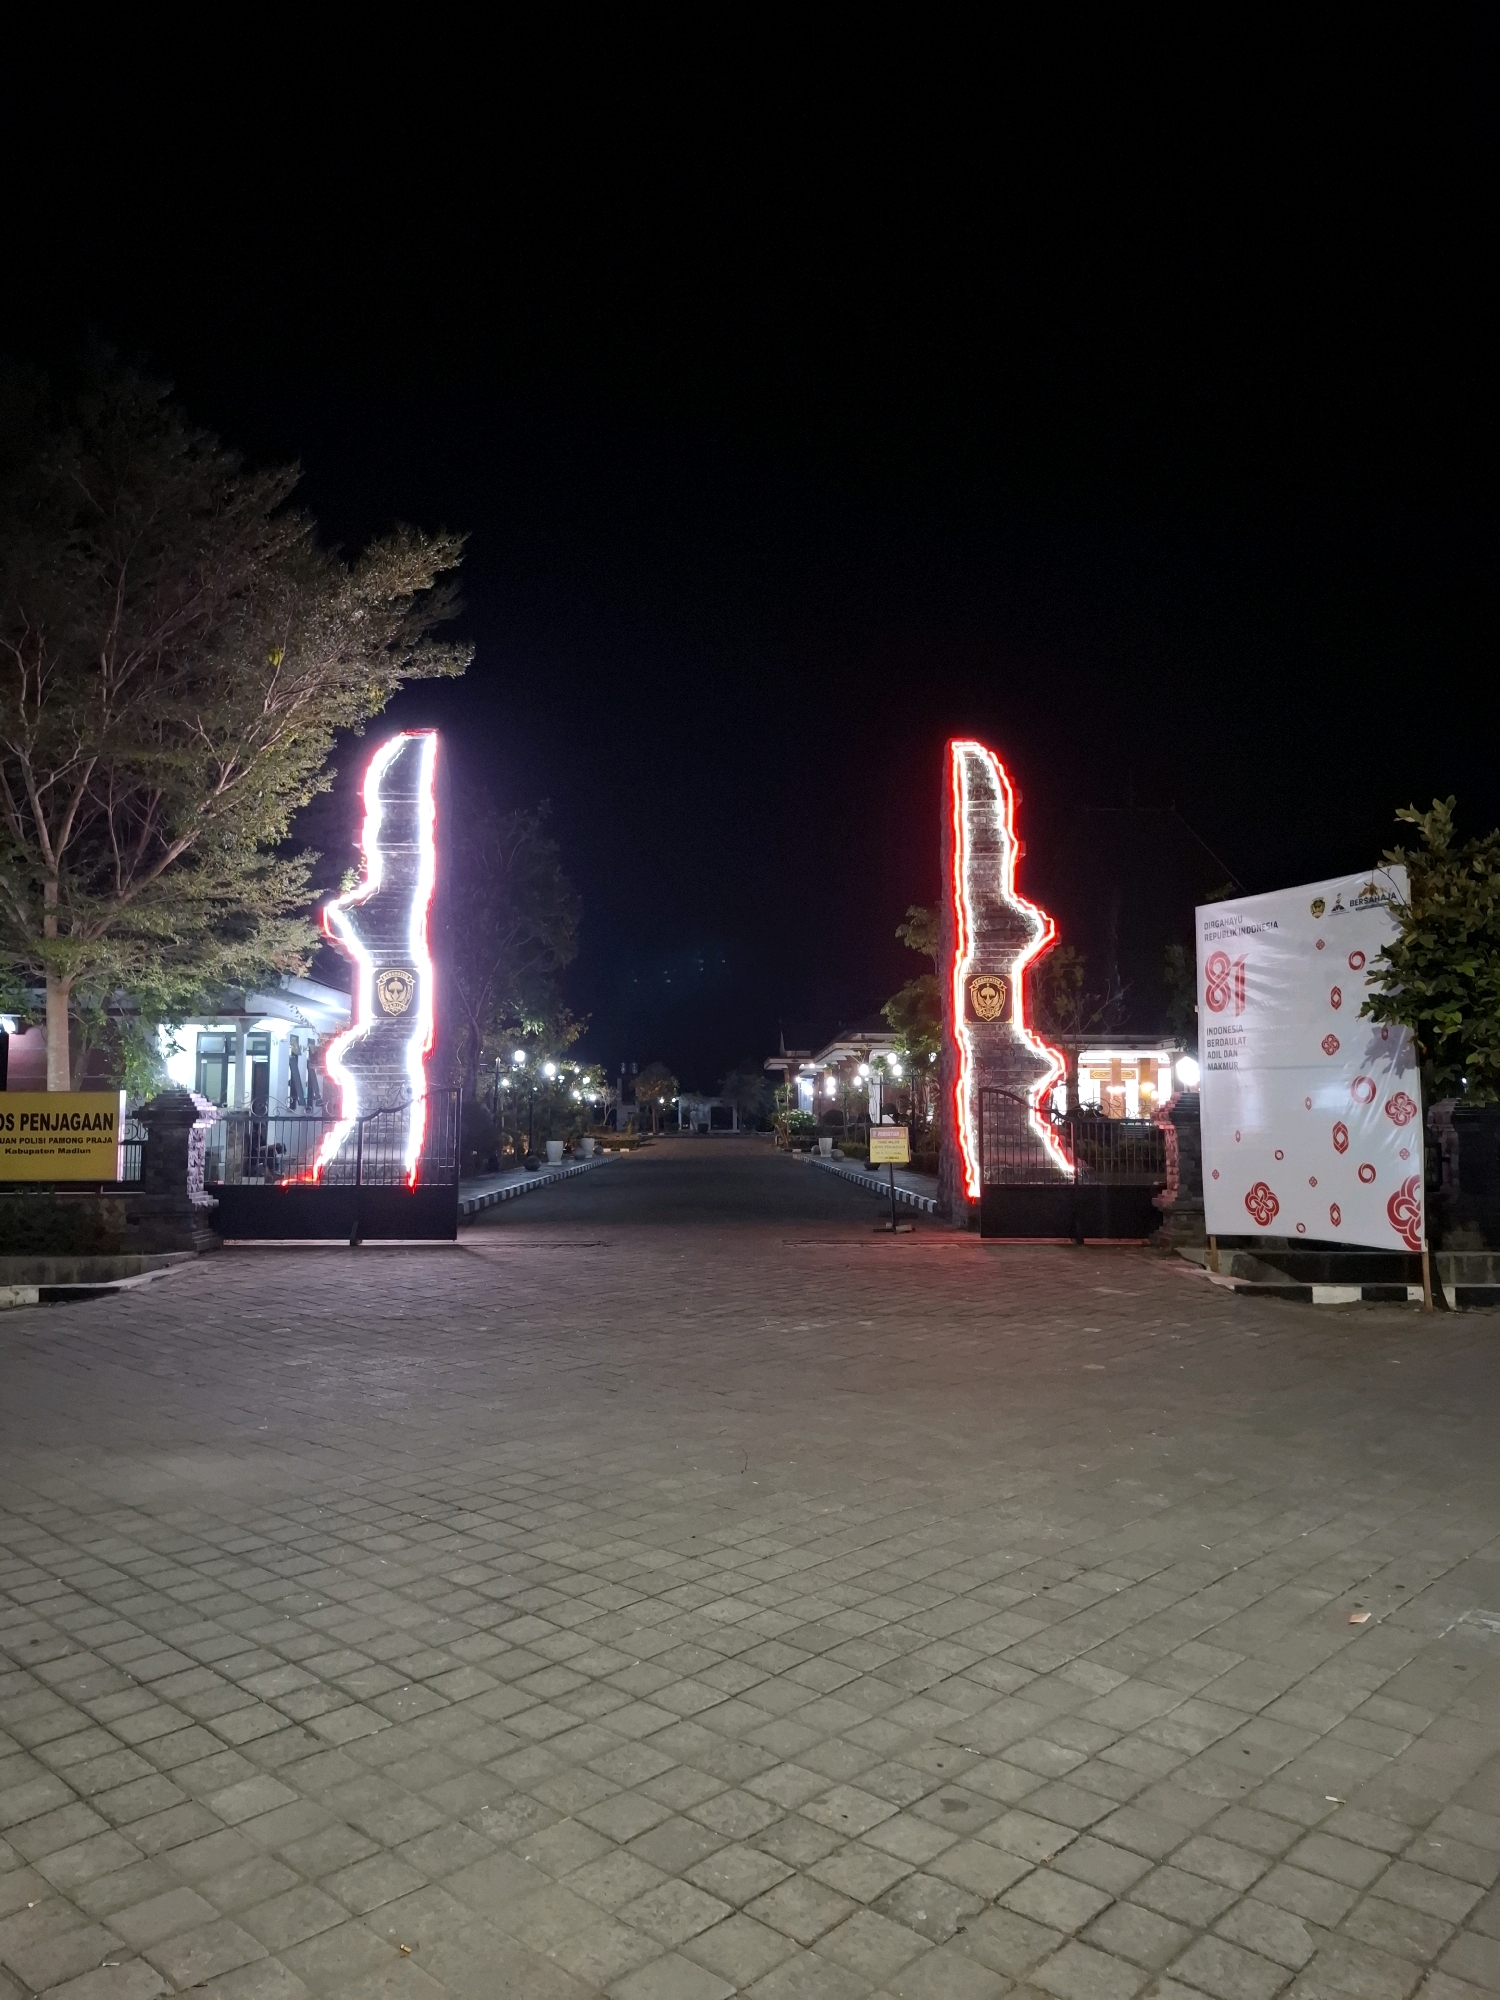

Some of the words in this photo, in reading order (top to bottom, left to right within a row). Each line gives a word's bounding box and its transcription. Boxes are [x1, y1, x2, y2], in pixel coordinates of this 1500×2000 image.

[1204, 915, 1243, 931] DIRGAHAYU
[1204, 928, 1238, 942] REPUBLIK
[1238, 920, 1279, 936] INDONESIA
[1206, 1024, 1244, 1036] INDONESIA
[1206, 1036, 1247, 1048] BERDAULAT
[1207, 1050, 1222, 1059] ADIL
[1223, 1049, 1238, 1059] DAN
[1207, 1060, 1239, 1071] MAKMUR
[20, 1112, 114, 1131] PENJAGAAN
[86, 1136, 113, 1144] PRAJA
[4, 1148, 55, 1156] Kabupaten
